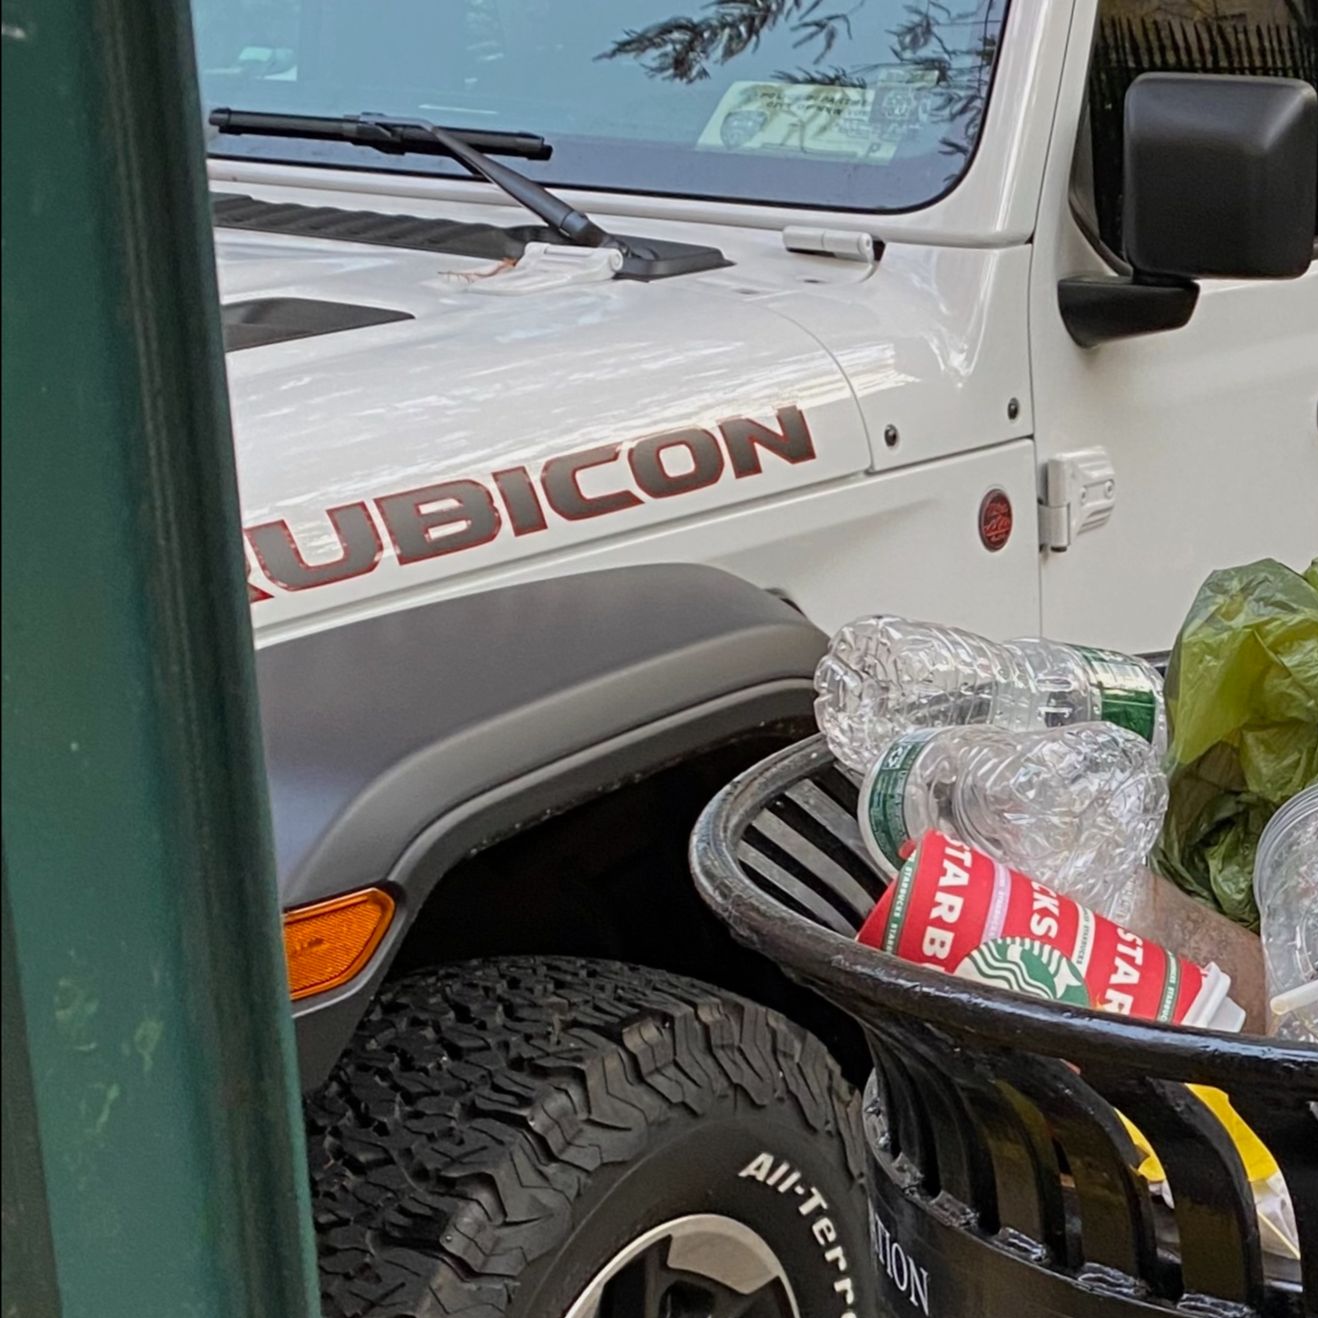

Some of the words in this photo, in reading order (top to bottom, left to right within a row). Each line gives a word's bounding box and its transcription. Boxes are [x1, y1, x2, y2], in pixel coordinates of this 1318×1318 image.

[246, 404, 817, 603] UBICON
[892, 866, 913, 917] STARBUCKS
[1076, 924, 1090, 965] STARBUCKS
[868, 1198, 929, 1316] TION
